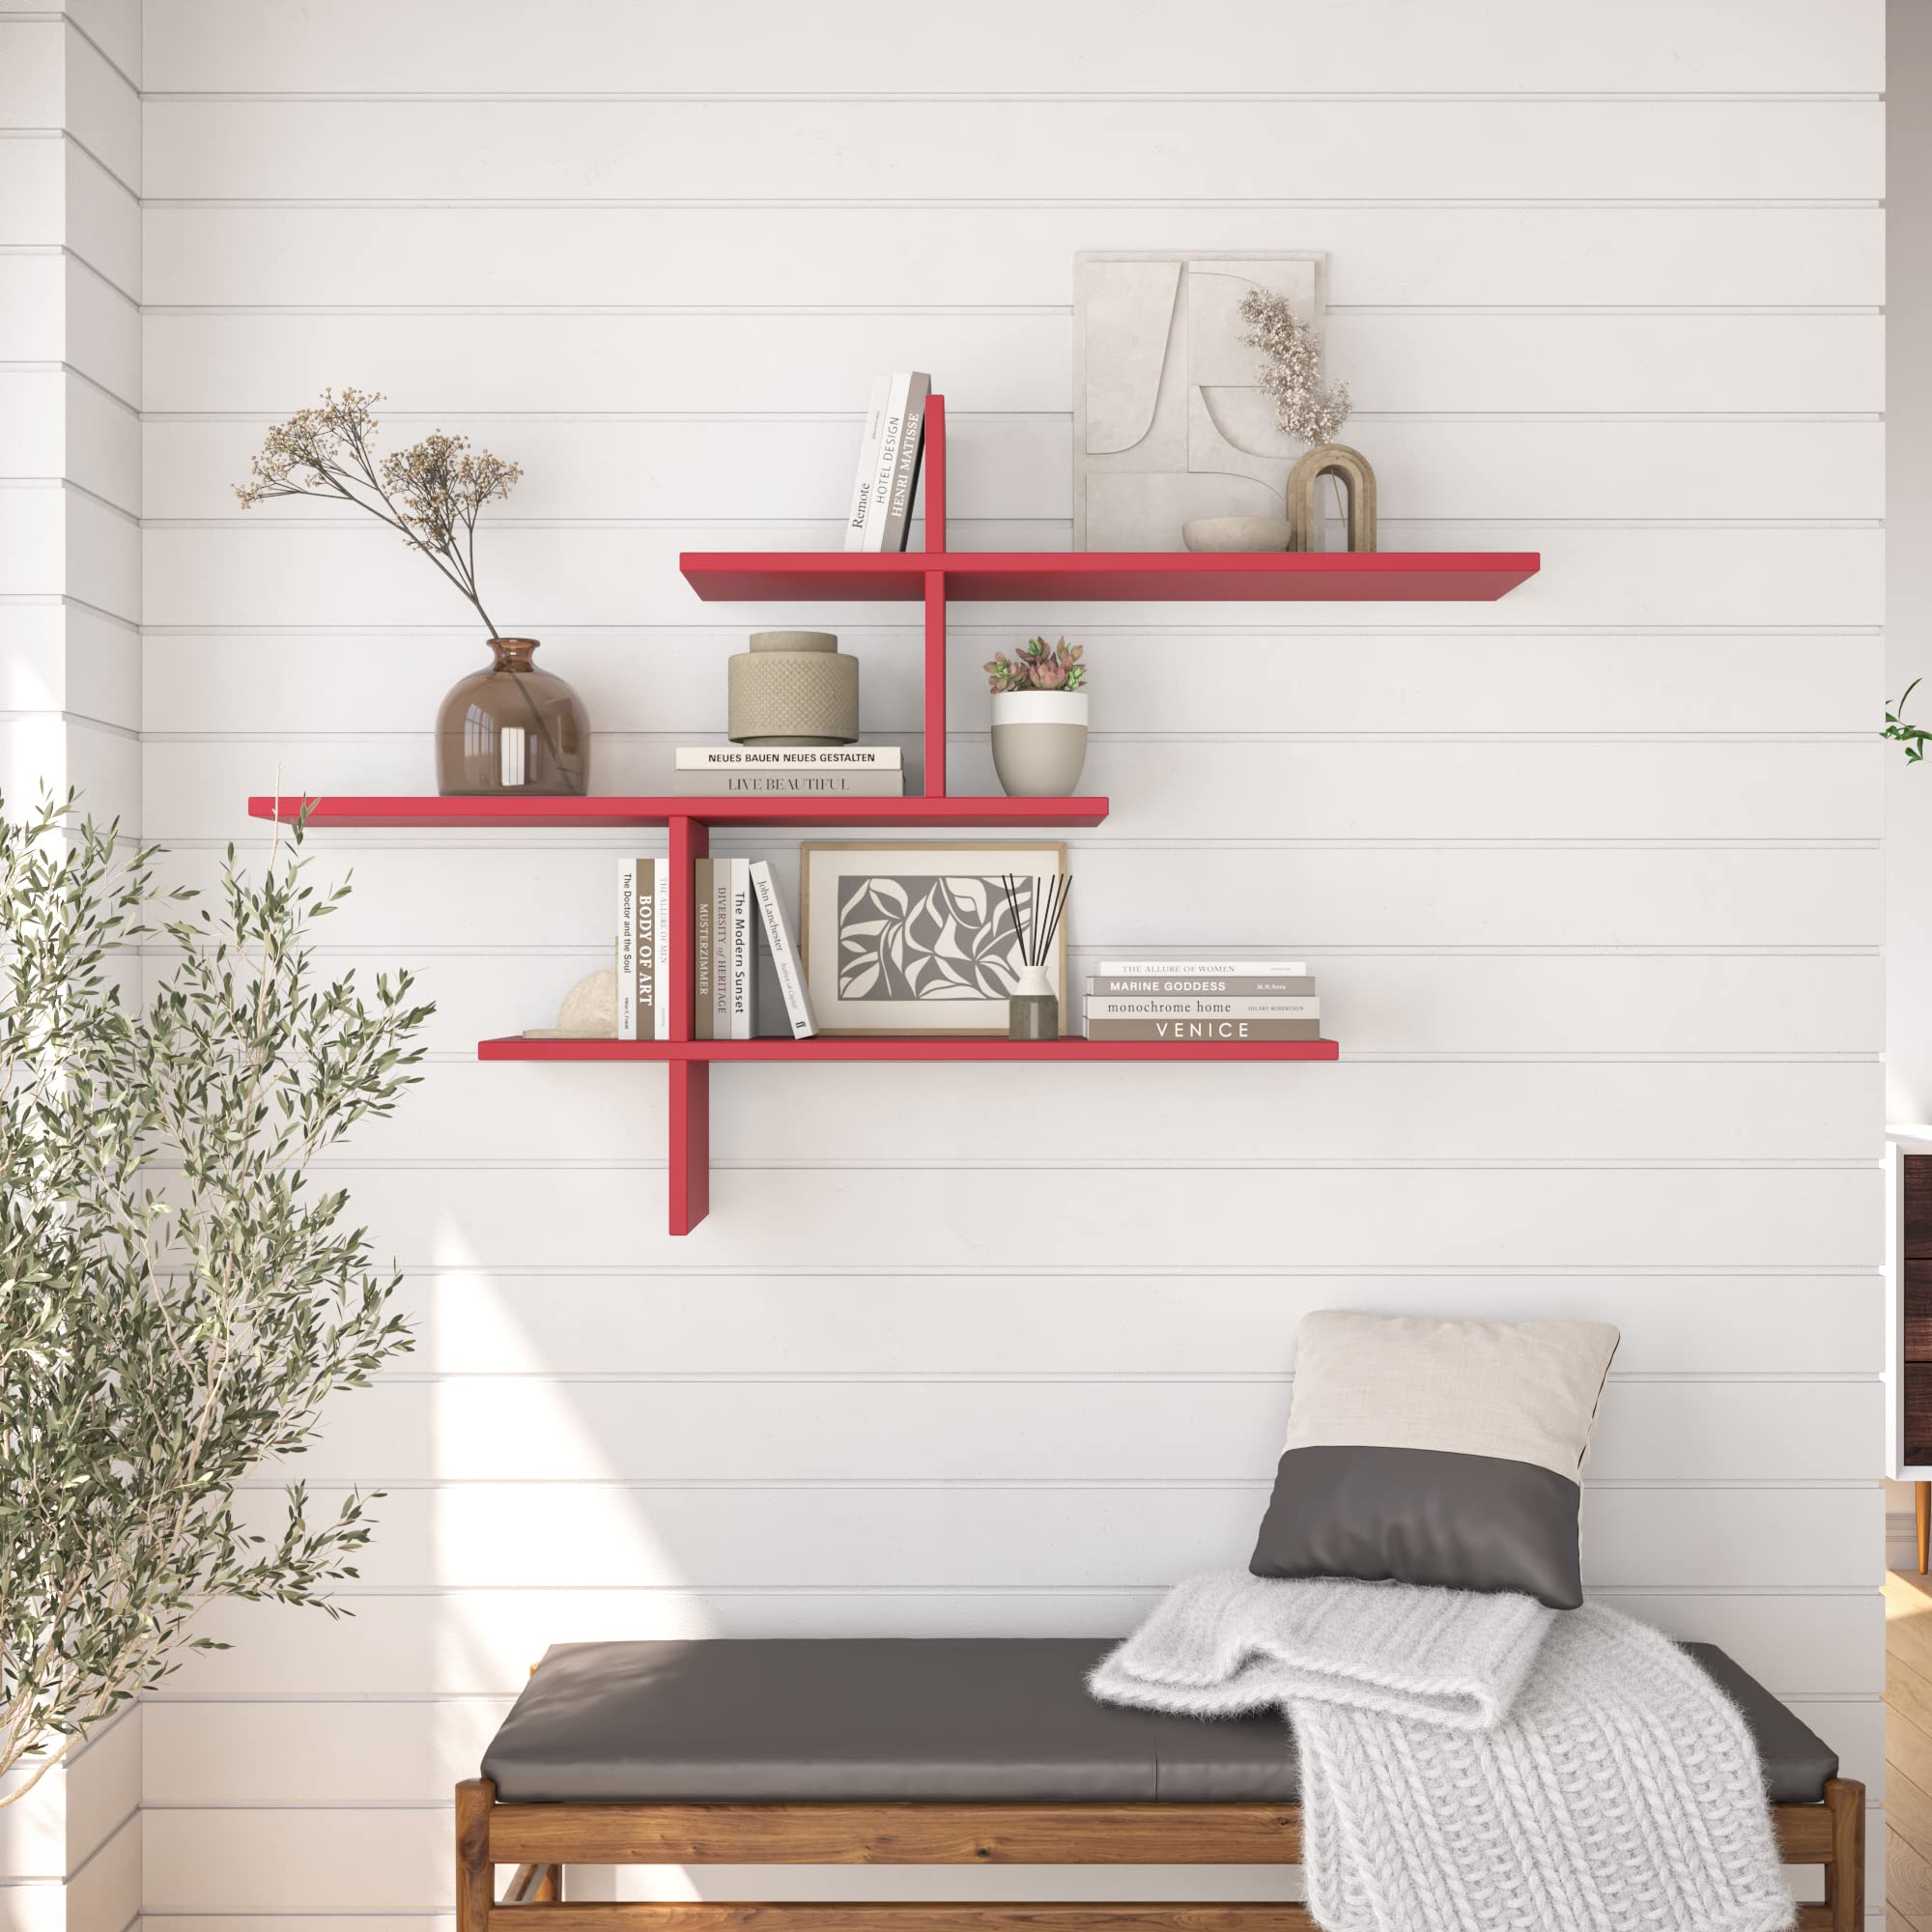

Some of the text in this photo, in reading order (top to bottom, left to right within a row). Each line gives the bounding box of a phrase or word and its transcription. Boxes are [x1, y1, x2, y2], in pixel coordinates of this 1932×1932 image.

[876, 417, 899, 503] HOTEL DESIGN
[892, 412, 919, 517] HENRI MATISSE
[852, 483, 870, 528] Remote
[709, 753, 875, 762] NEUES BAUEN NEUES GESTALTEN
[728, 778, 850, 790] LIVE BEAUTIFUL
[624, 873, 632, 973] The Doctor and the Soul
[639, 895, 652, 1006] BODY OF ART
[660, 878, 668, 964] THE ALLURE OF MEN
[699, 904, 708, 995] MUSTERZIMMER
[718, 887, 726, 1014] DIVERSITY of HERITAGE
[736, 892, 745, 1014] The Modern Sunset
[757, 880, 782, 952] John Lanchester
[1108, 1001, 1231, 1012] monochrome home
[1110, 982, 1226, 991] MARINE GODDESS
[1156, 1022, 1248, 1037] VENICE
